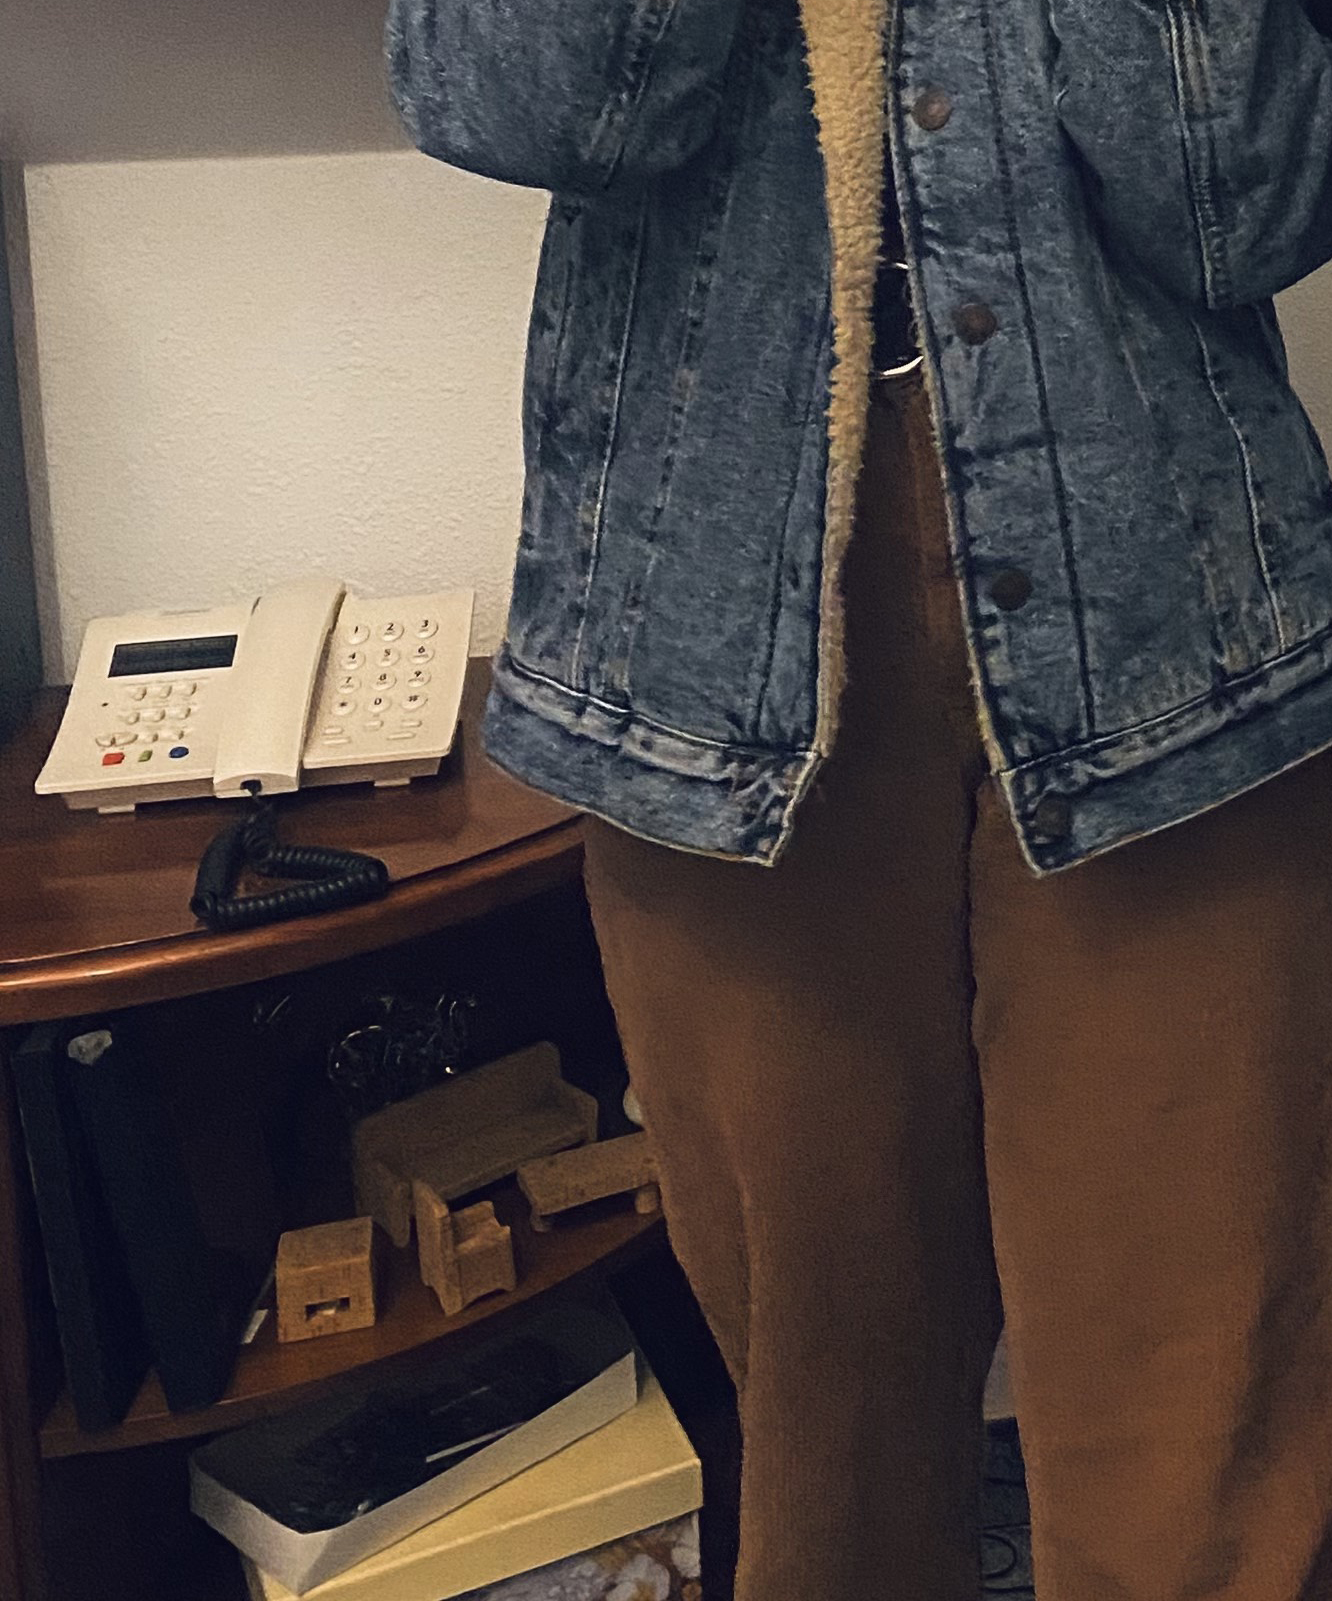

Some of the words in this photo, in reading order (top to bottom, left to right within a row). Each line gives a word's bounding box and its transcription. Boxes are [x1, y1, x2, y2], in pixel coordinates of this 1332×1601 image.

[387, 622, 395, 631] 2
[421, 619, 429, 628] 3
[417, 645, 425, 654] 6
